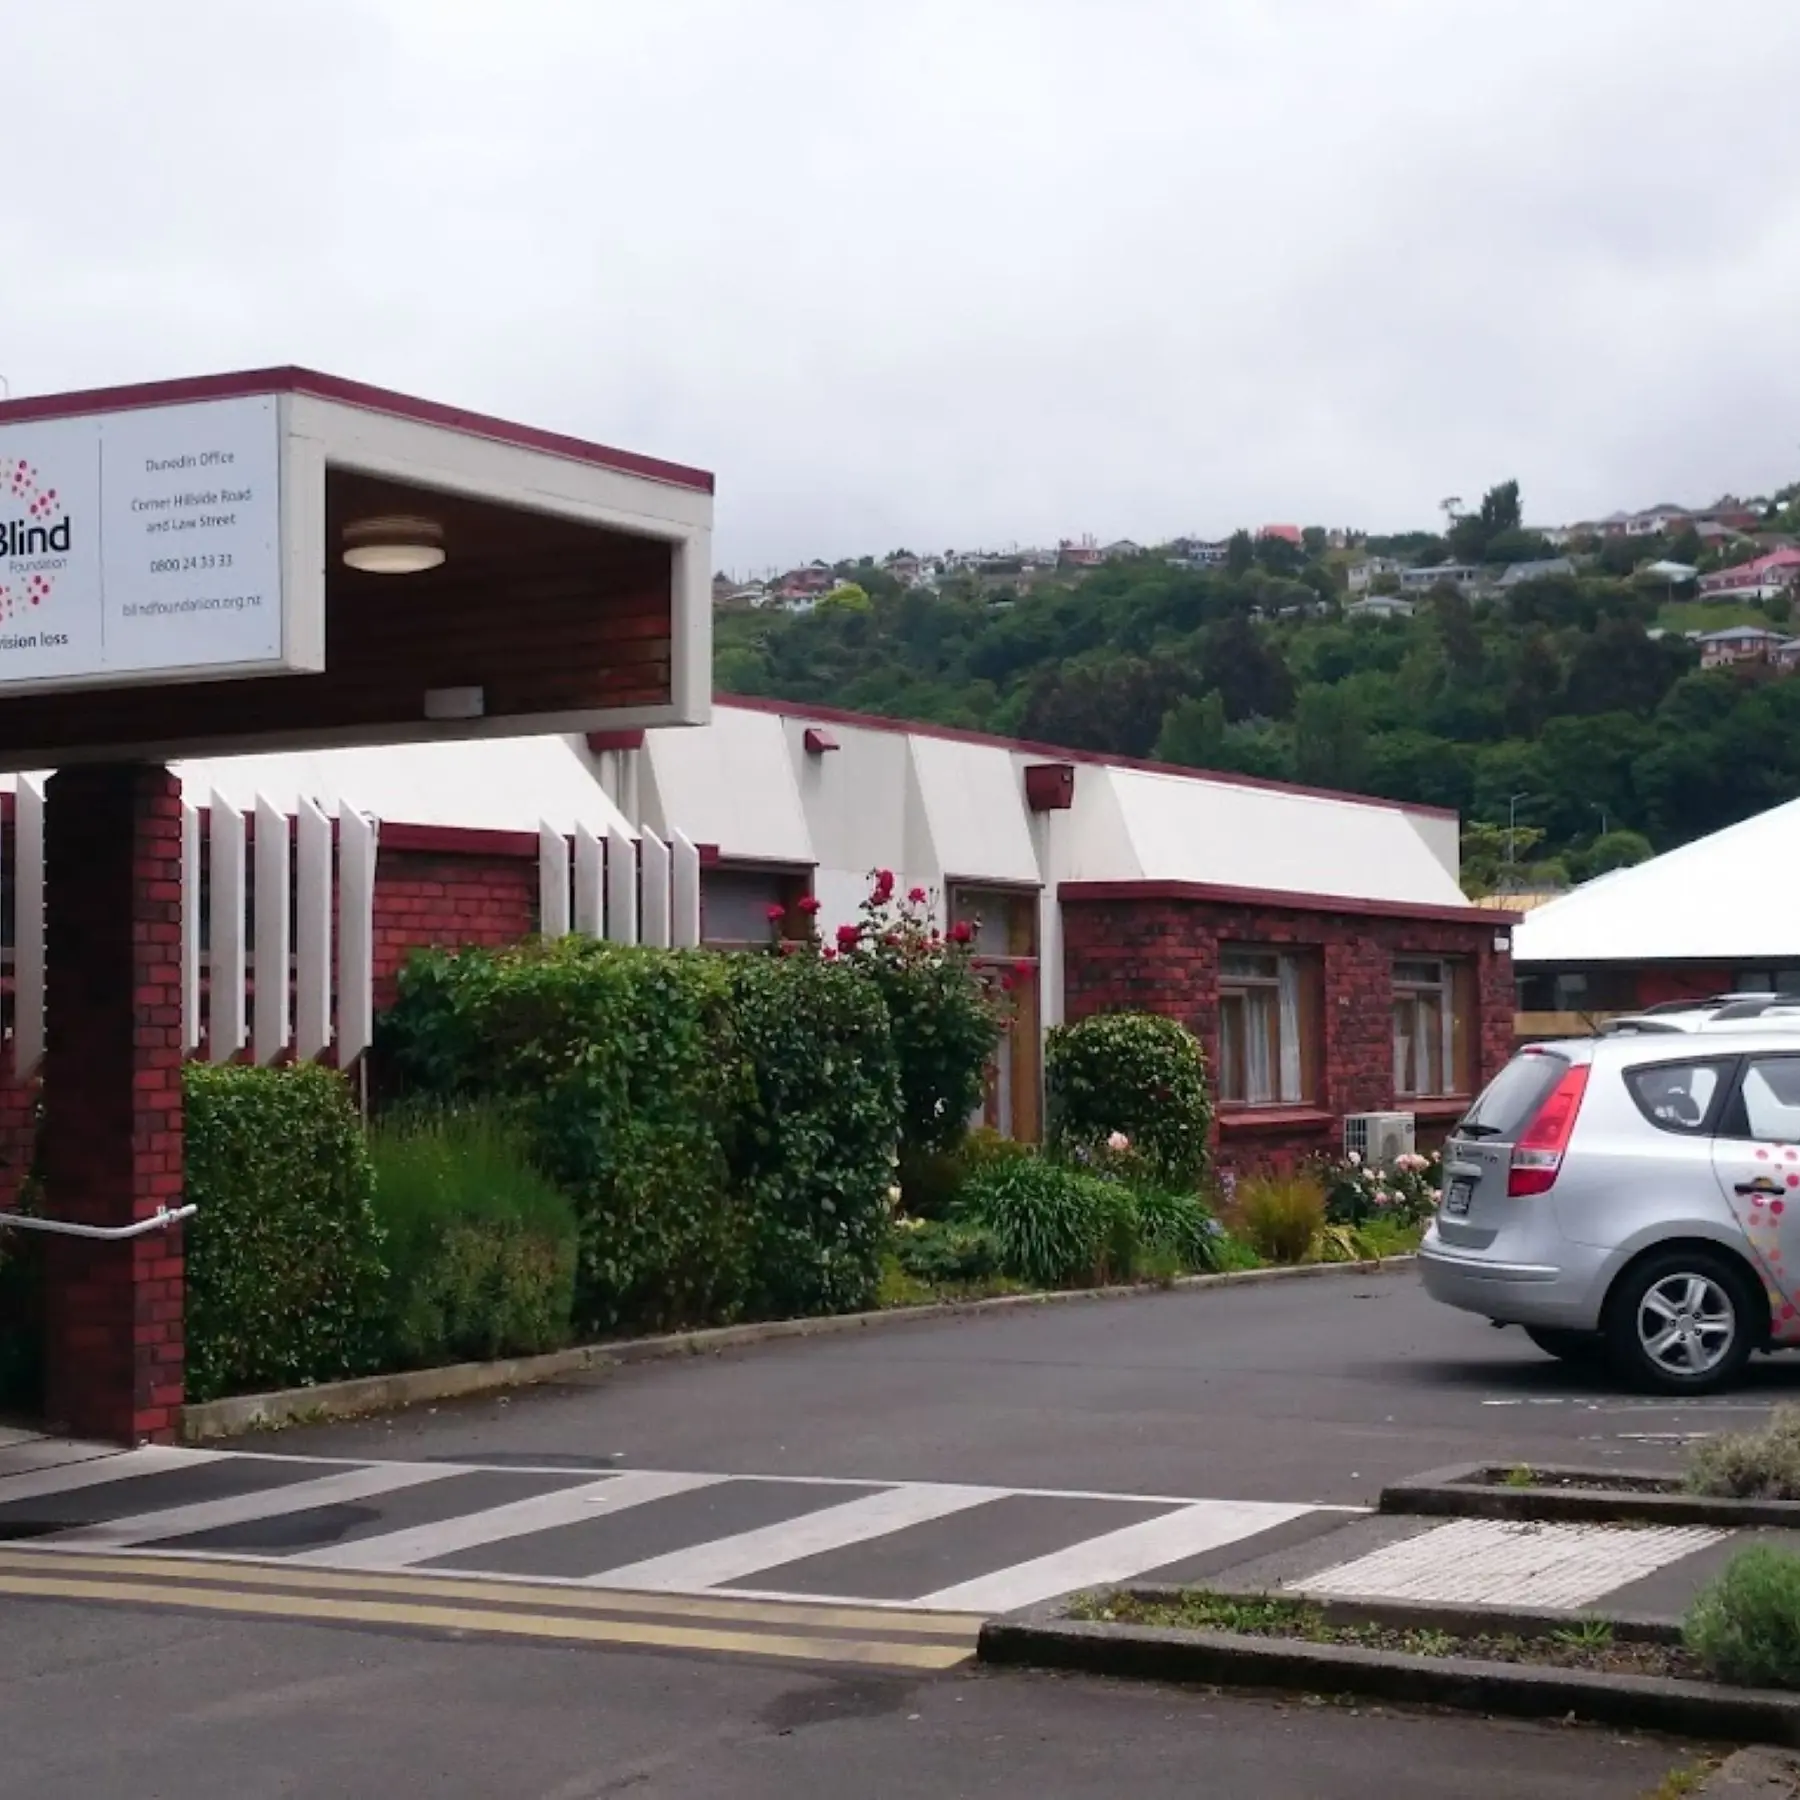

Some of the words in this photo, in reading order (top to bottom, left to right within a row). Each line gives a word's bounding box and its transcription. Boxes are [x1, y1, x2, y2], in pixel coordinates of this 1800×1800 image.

[145, 455, 197, 472] Dunedin
[199, 451, 235, 466] Office
[131, 498, 171, 512] Corner
[173, 490, 218, 507] Hillside
[220, 487, 252, 502] Road
[146, 518, 170, 533] and
[199, 513, 236, 528] Street
[9, 557, 68, 574] Foundation
[150, 558, 180, 573] 0800
[183, 556, 197, 570] 24
[219, 553, 233, 567] 33
[40, 631, 69, 647] loss
